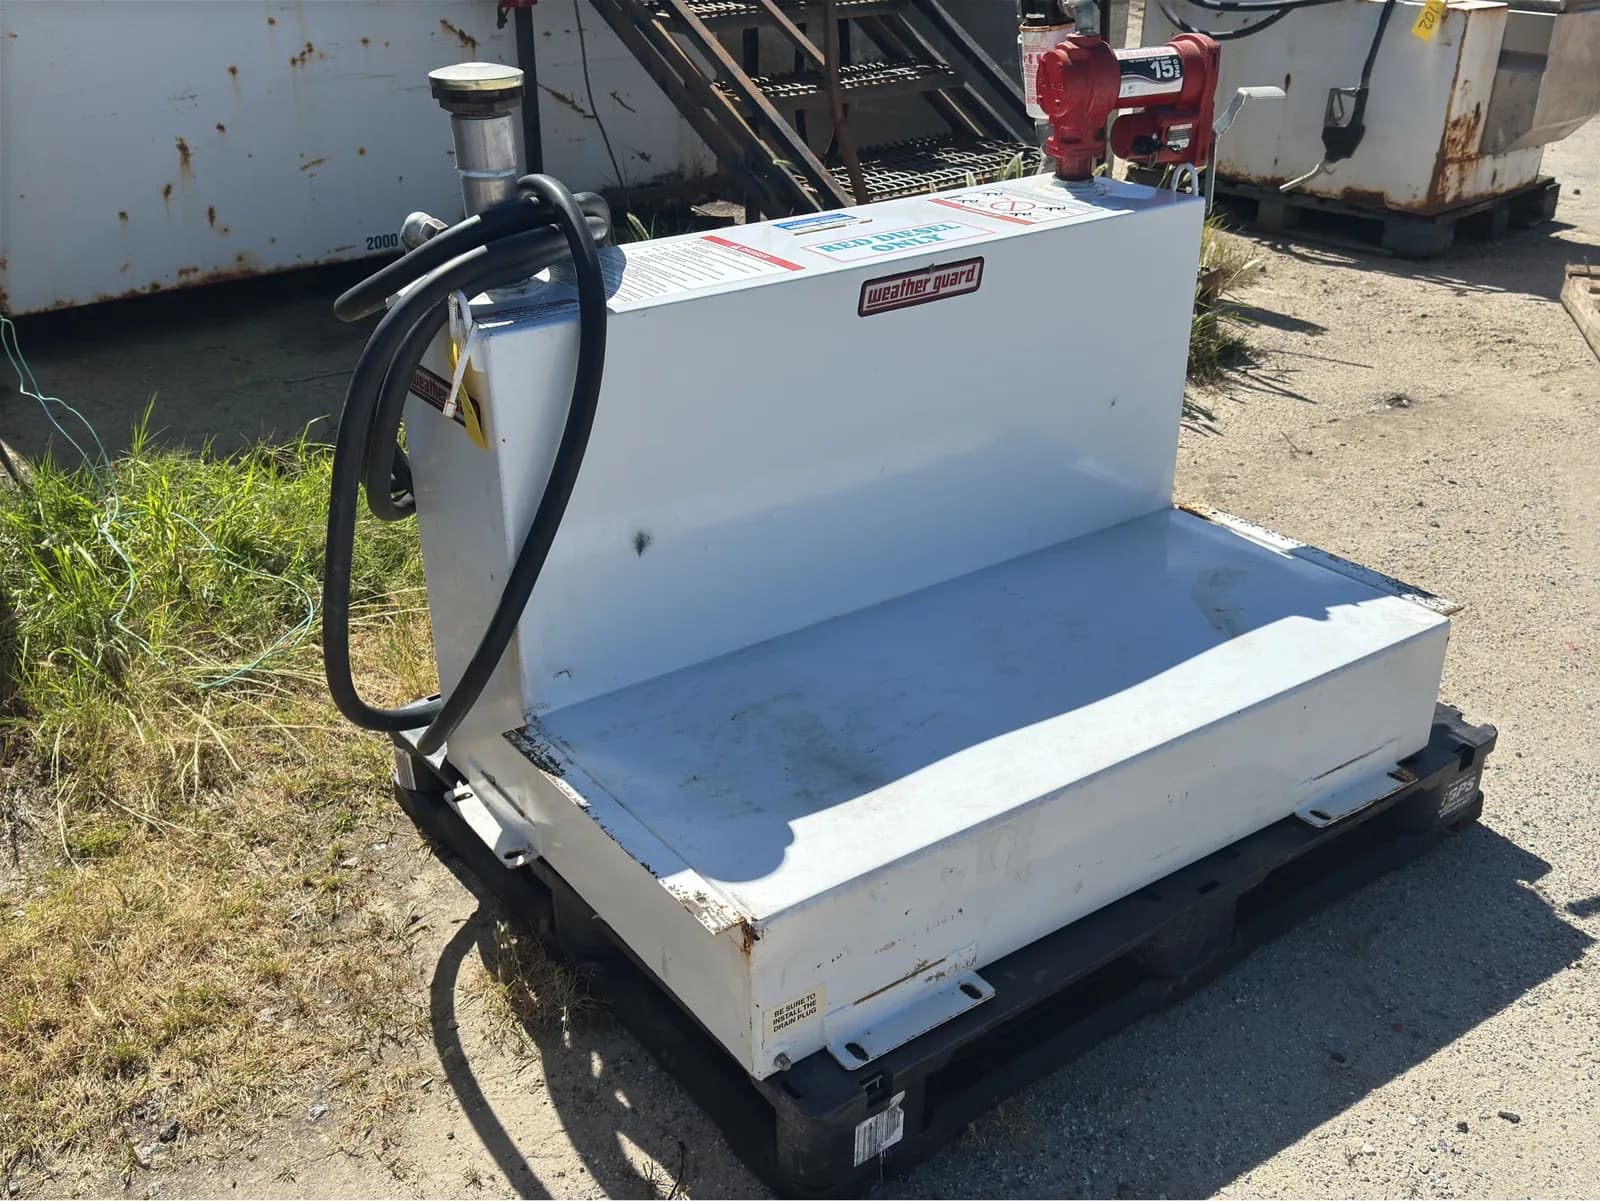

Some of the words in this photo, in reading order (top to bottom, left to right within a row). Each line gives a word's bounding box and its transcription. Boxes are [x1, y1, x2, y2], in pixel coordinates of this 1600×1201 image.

[1150, 60, 1175, 79] 15
[366, 233, 399, 250] 2000
[819, 237, 874, 253] RED
[874, 221, 961, 243] DIESEL
[871, 234, 945, 252] ONLY
[867, 276, 931, 305] weather
[932, 264, 976, 294] guard
[773, 1007, 802, 1026] INSTALL
[803, 999, 817, 1011] THE
[774, 1007, 785, 1018] BE
[785, 997, 806, 1012] SURE
[806, 993, 816, 1001] TO
[773, 1017, 796, 1033] DRAIN
[797, 1007, 817, 1021] PLUG
